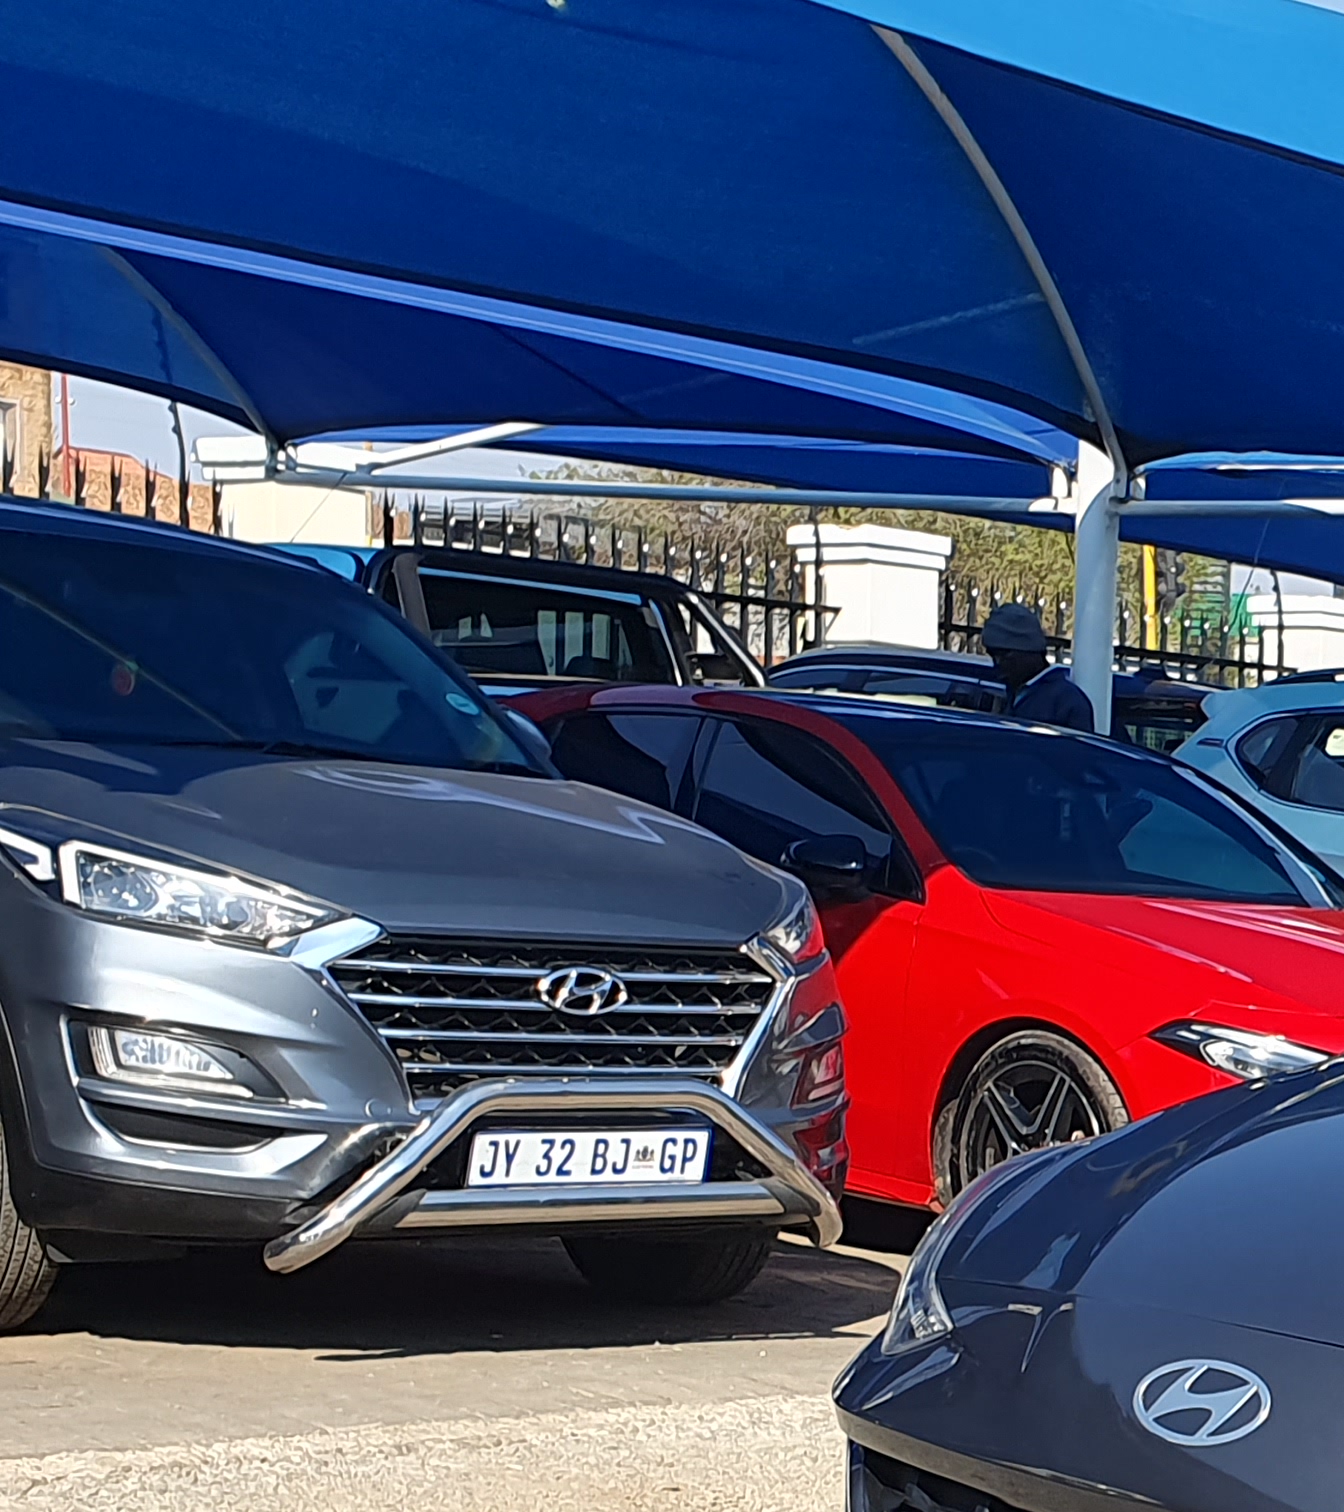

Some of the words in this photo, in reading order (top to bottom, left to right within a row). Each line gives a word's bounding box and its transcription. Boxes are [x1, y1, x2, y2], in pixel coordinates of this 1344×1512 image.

[479, 1139, 521, 1178] JY
[535, 1138, 576, 1177] 32
[590, 1138, 632, 1176] BJ
[659, 1137, 698, 1175] GP
